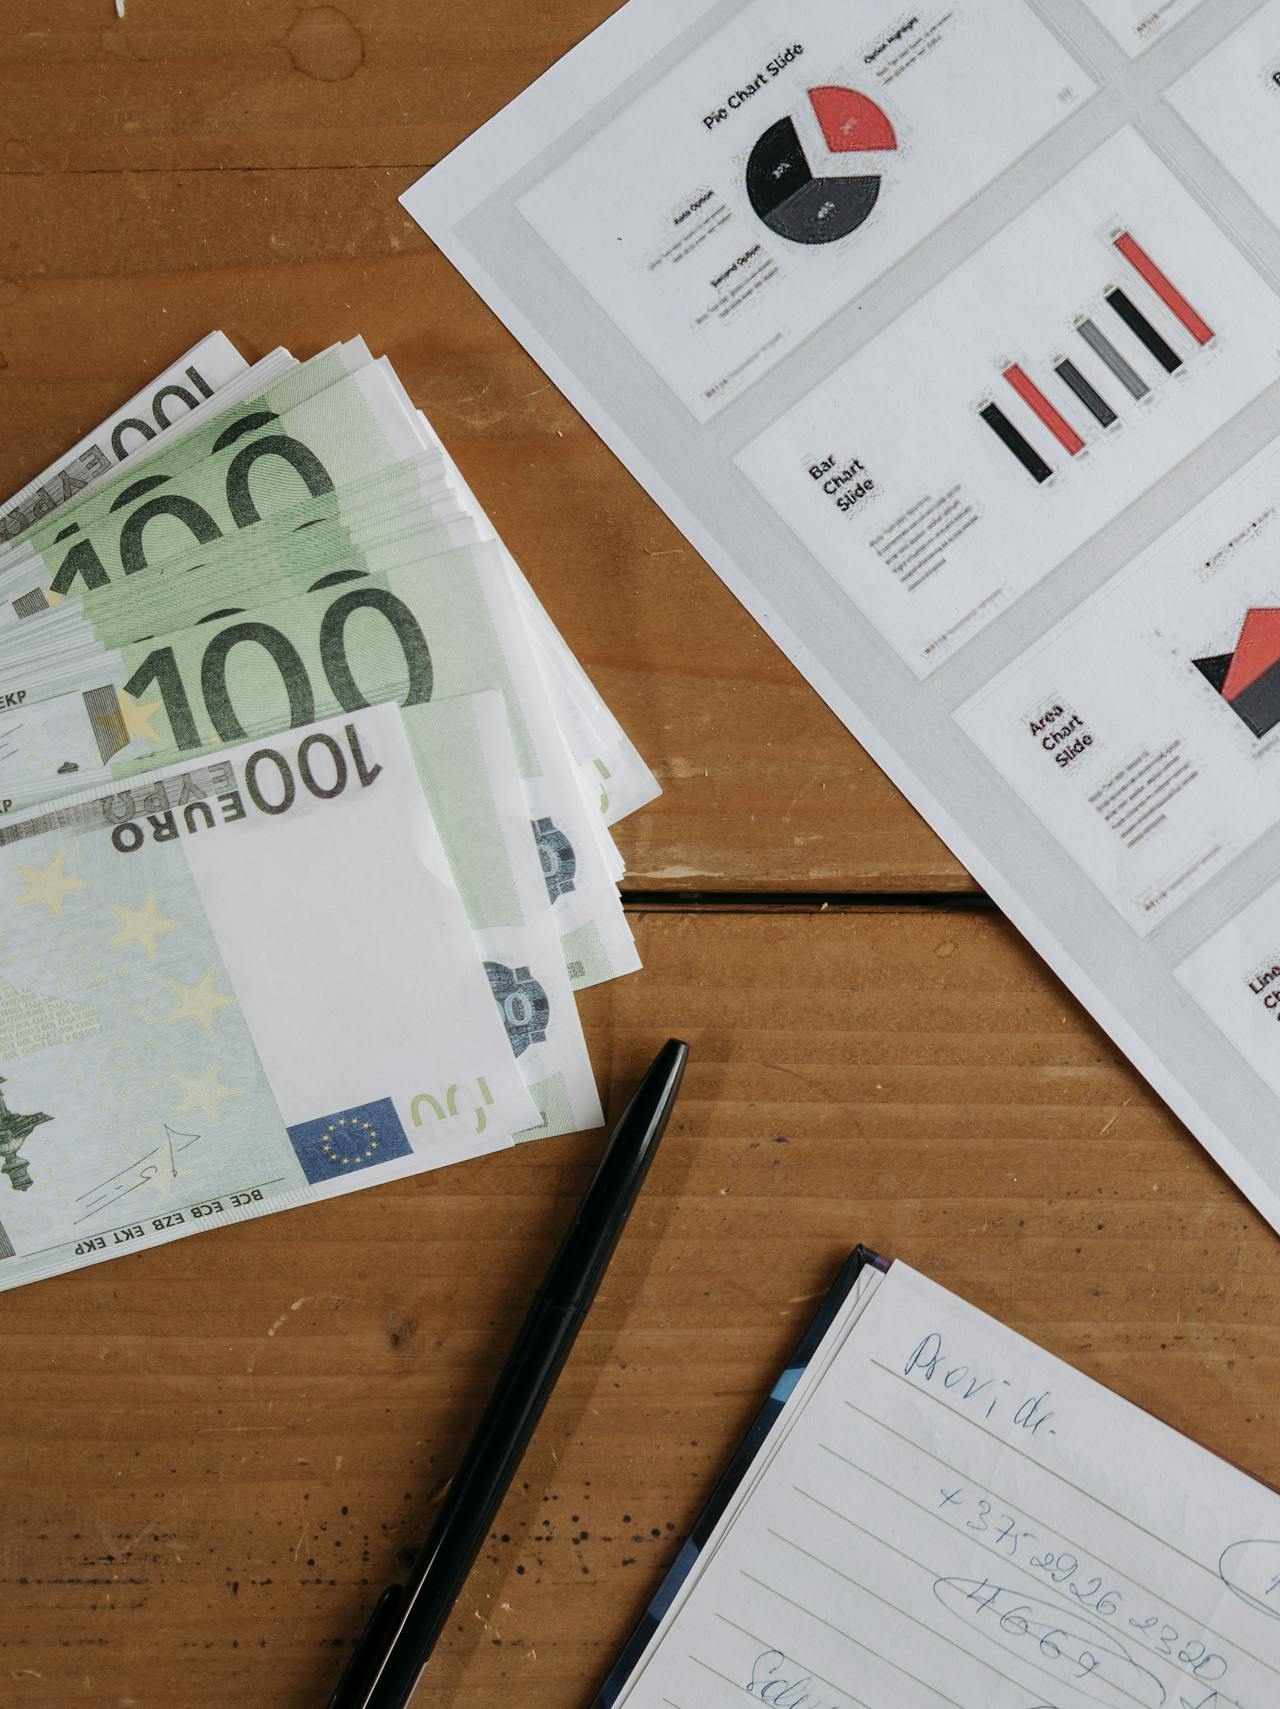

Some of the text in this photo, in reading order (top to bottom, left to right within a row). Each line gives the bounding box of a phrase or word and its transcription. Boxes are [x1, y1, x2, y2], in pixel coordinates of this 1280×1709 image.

[703, 44, 804, 130] Pie Chart Slide
[808, 455, 836, 480] Bar
[823, 460, 864, 495] Chart
[836, 479, 874, 512] Slide
[124, 569, 434, 751] 100
[1030, 705, 1064, 736] Area
[1042, 715, 1083, 750] Chart
[1055, 733, 1093, 768] Slide
[111, 723, 384, 854] 100 EURO
[73, 1188, 264, 1256] BCE ECB EZB EKT EKP
